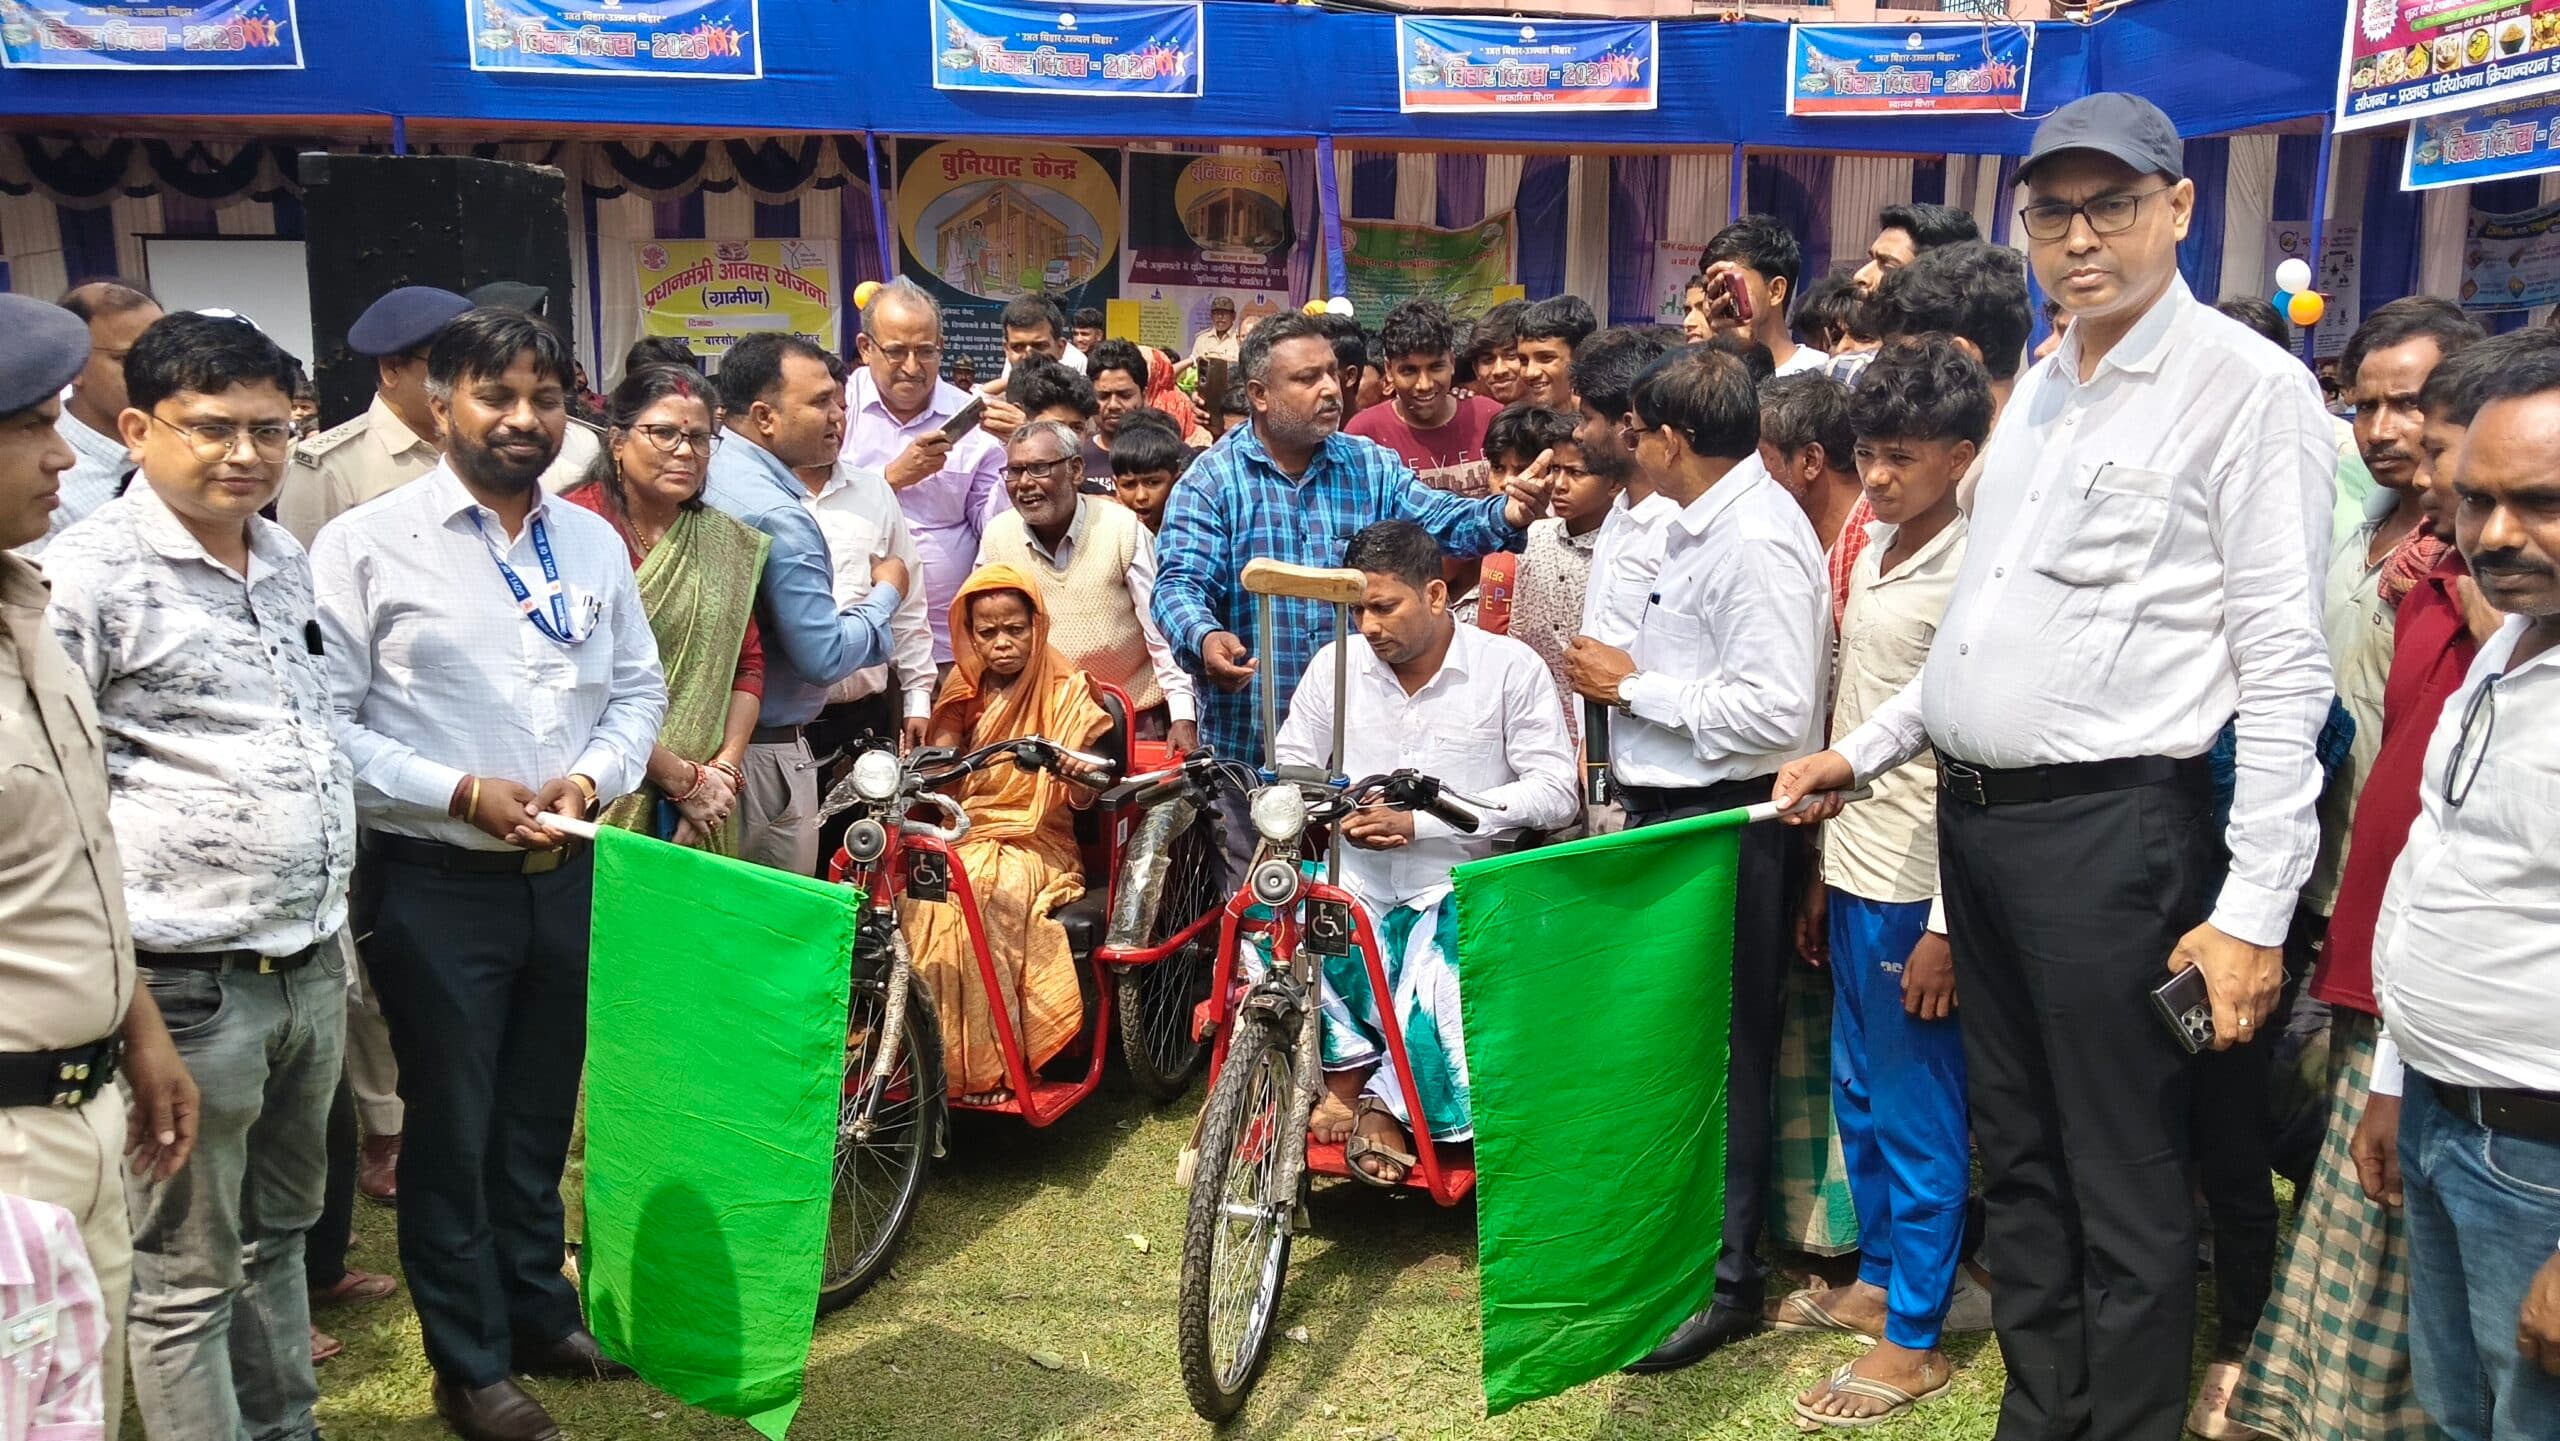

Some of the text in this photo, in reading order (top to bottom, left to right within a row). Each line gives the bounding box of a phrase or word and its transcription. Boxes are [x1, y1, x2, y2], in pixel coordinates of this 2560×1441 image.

[39, 19, 104, 51] बिहार
[104, 19, 168, 51] दिवस
[183, 24, 246, 51] 2026
[518, 23, 578, 55] बिहार
[578, 23, 636, 57] दिवस
[652, 33, 710, 60] 2026
[977, 44, 1034, 75] बिहार
[1034, 45, 1089, 78] दिवस
[1103, 53, 1157, 80] 2026
[1444, 59, 1498, 87] बिहार
[1498, 59, 1548, 88] दिवस
[1562, 62, 1613, 87] 2026
[1834, 65, 1883, 94] बिहार
[1883, 65, 1933, 94] दिवस
[1944, 69, 1992, 95] 2026
[2355, 91, 2389, 112] सौजन्य
[2398, 83, 2430, 105] प्रखण्ड
[2432, 72, 2484, 96] परियोजना
[2486, 57, 2550, 86] क्रियान्वयन
[2443, 127, 2487, 165] बिहार
[2487, 119, 2539, 159] दिवस
[940, 148, 1078, 181] बुनियाद केन्द्र
[1191, 160, 1282, 185] बुनियाद केन्द्र
[643, 257, 828, 314] प्रधानमंत्री आवास योजना
[702, 286, 769, 310] (ग्रामीण)
